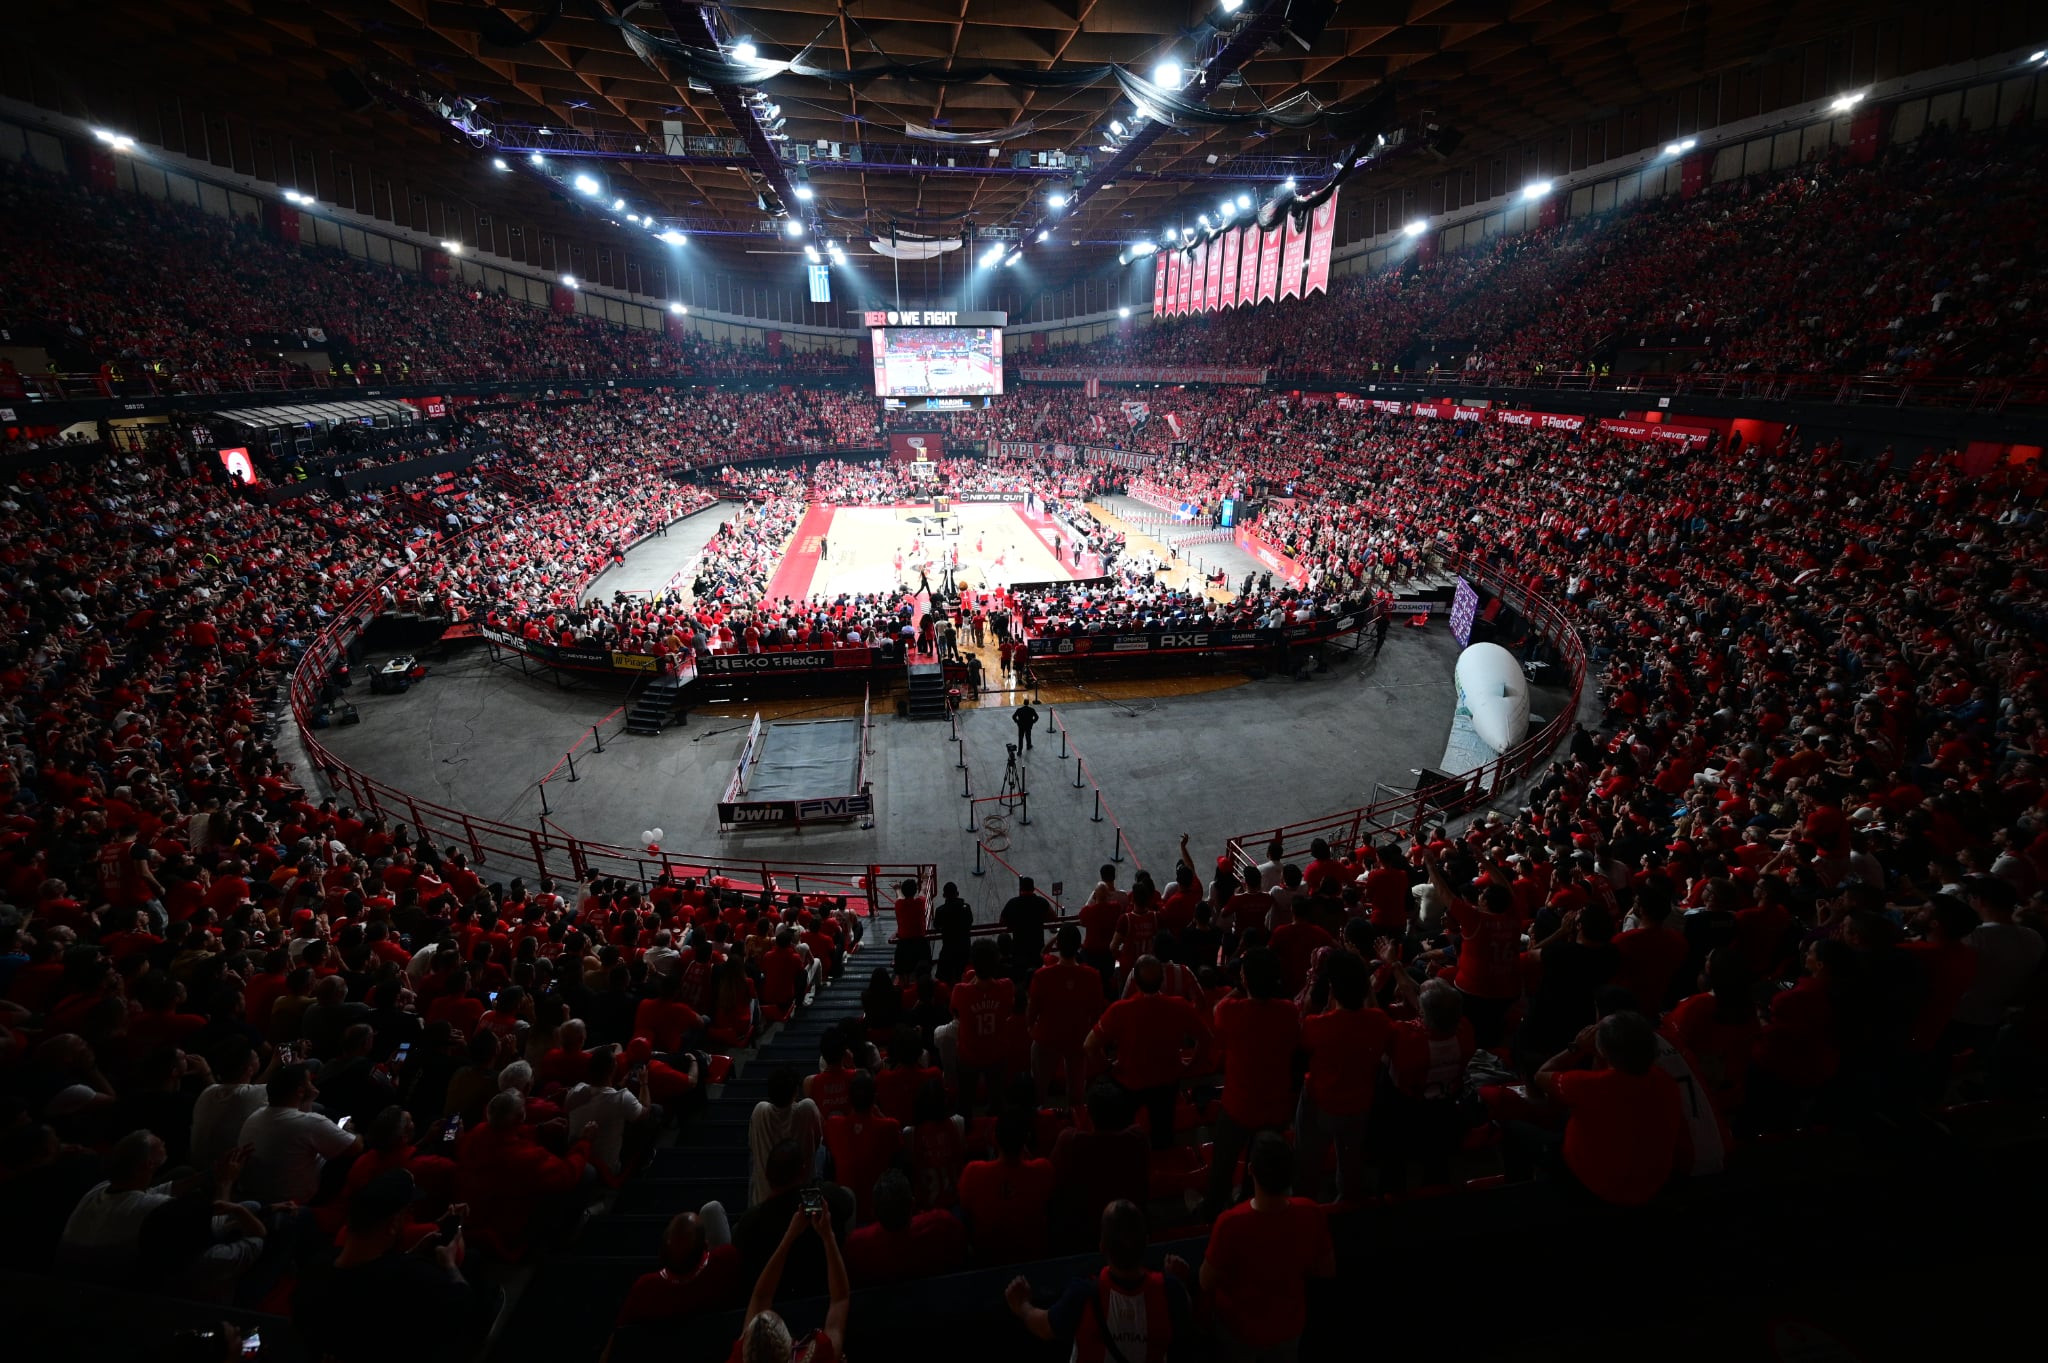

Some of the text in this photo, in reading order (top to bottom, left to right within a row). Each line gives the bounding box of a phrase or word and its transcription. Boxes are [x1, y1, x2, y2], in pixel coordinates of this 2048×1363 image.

[900, 311, 957, 325] WE FIGHT
[1415, 404, 1437, 418] bwin
[1453, 407, 1479, 421] bwin
[1503, 412, 1532, 425] FlexCar
[1548, 416, 1582, 430] FlexCar
[1607, 425, 1646, 435] NEVER QUIT
[1661, 431, 1686, 440] NEVER
[1160, 634, 1209, 647] AXE
[731, 658, 769, 668] EKO
[782, 656, 826, 666] FlexCar
[733, 803, 784, 821] bwin
[975, 1013, 996, 1037] 13
